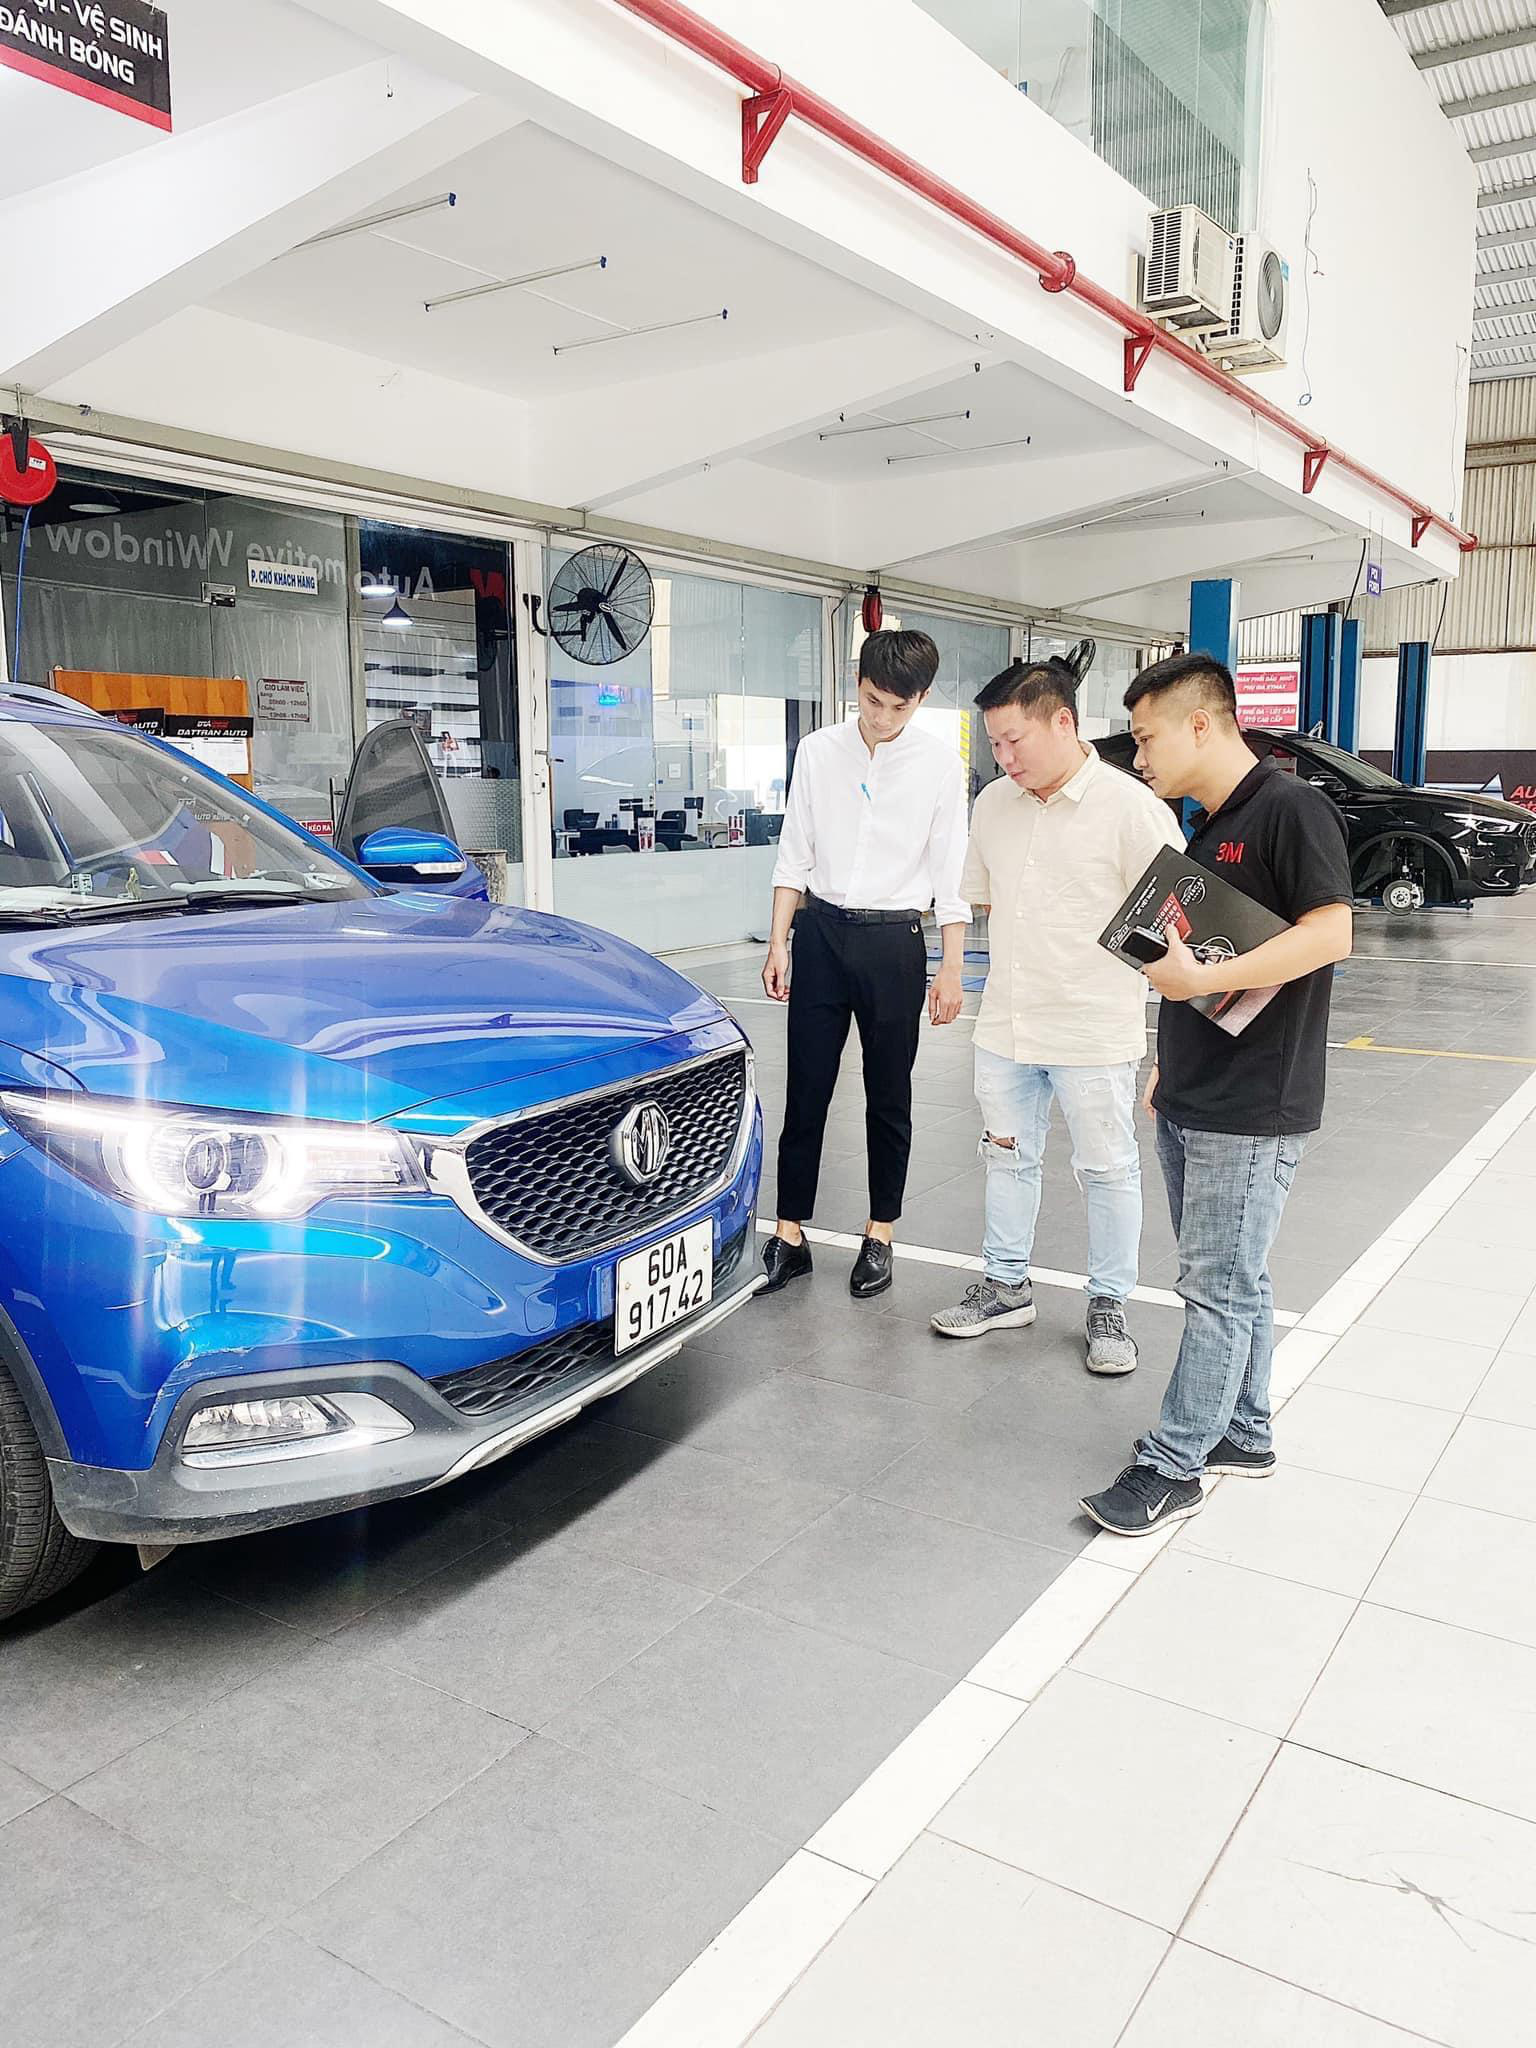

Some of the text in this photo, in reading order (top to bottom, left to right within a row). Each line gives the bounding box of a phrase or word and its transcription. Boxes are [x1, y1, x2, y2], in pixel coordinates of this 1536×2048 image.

[0, 6, 135, 85] ĐÁNH BÓNG
[73, 0, 105, 39] VỆ
[110, 16, 163, 60] SINH
[251, 569, 258, 583] P.
[273, 568, 296, 587] KHÁCH
[297, 571, 316, 589] HÀNG
[132, 721, 158, 730] AUTO
[222, 729, 248, 737] AUTO
[1216, 841, 1245, 864] 3M
[628, 1102, 669, 1178] MG
[648, 1236, 688, 1287] 60A
[629, 1269, 704, 1340] 917.42
